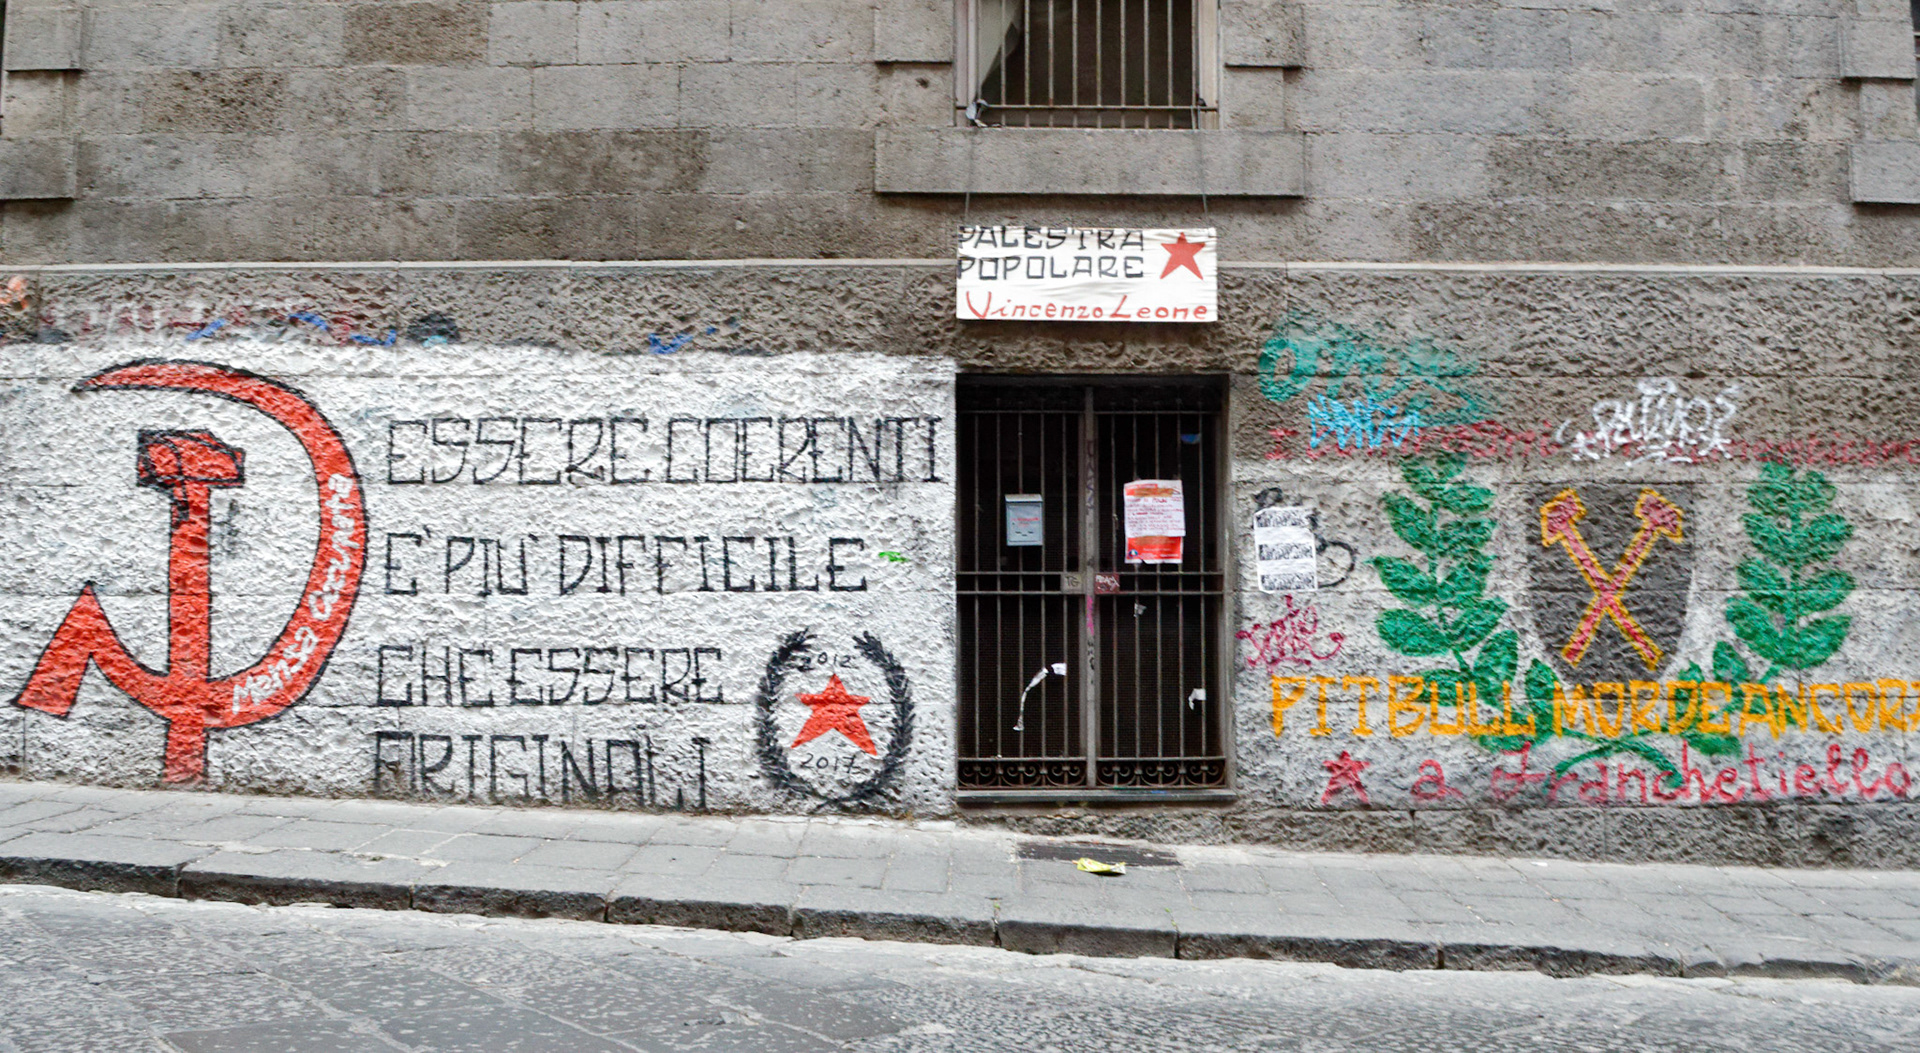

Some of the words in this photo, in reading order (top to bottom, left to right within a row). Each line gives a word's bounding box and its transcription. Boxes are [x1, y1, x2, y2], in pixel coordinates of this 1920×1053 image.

[958, 225, 1144, 251] PALESTRA
[957, 255, 1144, 280] POPOLARE
[966, 291, 1103, 319] Vincenzo
[1109, 295, 1207, 320] Leone
[385, 416, 652, 485] ESSERE
[666, 416, 942, 484] COERENTI
[558, 535, 867, 596] DIFFICILE
[376, 645, 494, 707] CHE
[509, 646, 724, 704] ESSERE
[800, 752, 860, 774] 2017
